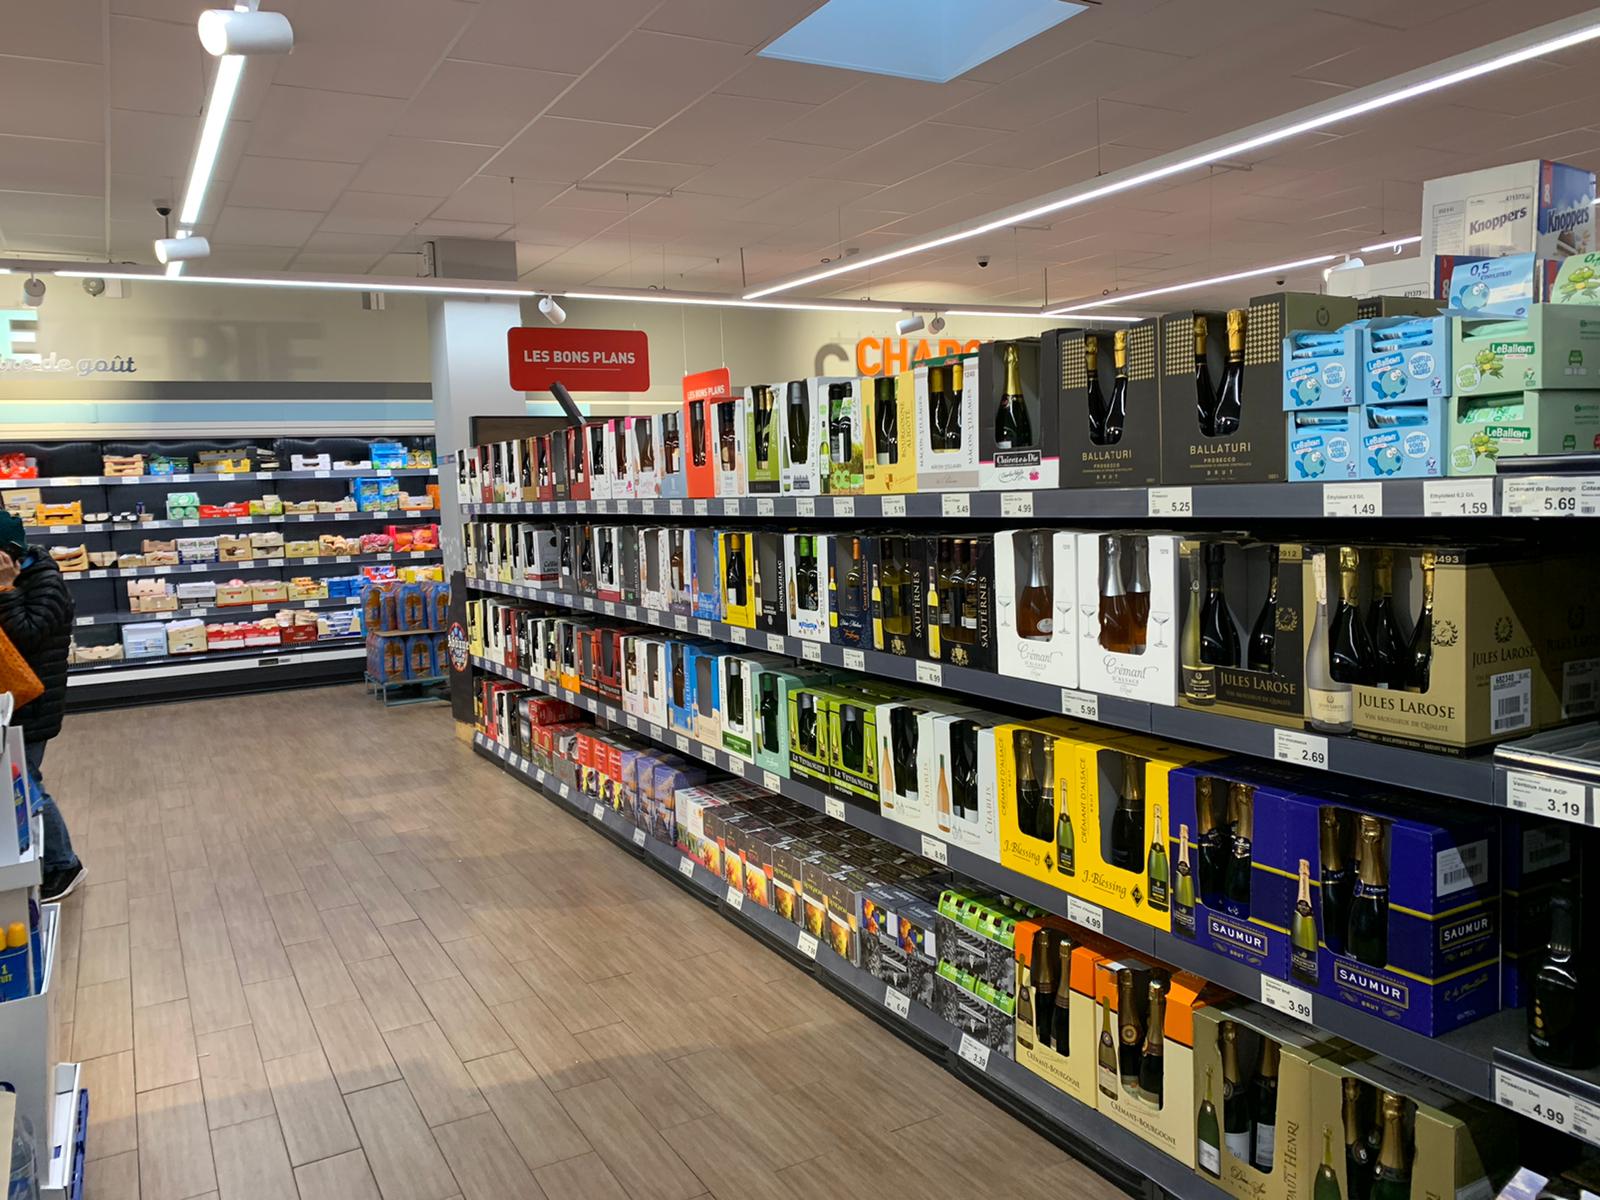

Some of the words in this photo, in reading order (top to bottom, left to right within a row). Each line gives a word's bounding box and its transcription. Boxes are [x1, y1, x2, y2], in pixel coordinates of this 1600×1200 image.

[1469, 205, 1528, 236] Knoppers
[1546, 206, 1590, 237] Knoppers
[1469, 262, 1491, 278] 0,5
[41, 351, 74, 372] de
[77, 355, 137, 377] goût
[524, 350, 550, 363] LES
[553, 350, 590, 363] BONS
[593, 351, 636, 364] PLANS
[687, 391, 696, 400] LES
[696, 388, 708, 399] BONS
[708, 385, 726, 397] PLANS
[1082, 449, 1133, 462] BALLATURI
[1189, 442, 1252, 456] BALLATURI
[1027, 453, 1040, 463] Die
[1203, 456, 1237, 464] PROSECCO
[956, 503, 969, 513] 5.49
[1017, 503, 1032, 513] 4.99
[1171, 501, 1191, 512] 5.25
[1352, 503, 1376, 515] 1.49
[1460, 502, 1488, 515] 1.59
[1544, 496, 1576, 511] 5.69
[777, 560, 785, 612] MONBAZILLAC
[1017, 640, 1064, 664] Crémant
[1472, 650, 1498, 668] JULES
[1501, 646, 1537, 663] LAROSE
[1102, 654, 1160, 679] Crémant
[1112, 676, 1140, 685] D'ALSACE
[1220, 671, 1251, 689] JULES
[1253, 676, 1297, 696] LAROSE
[1080, 704, 1097, 716] 5.99
[1358, 692, 1395, 710] JULES
[1399, 698, 1456, 720] LAROSE
[1301, 749, 1325, 764] 2.69
[984, 785, 993, 835] CHABLIS
[1547, 798, 1580, 816] 3.19
[1080, 803, 1088, 844] CRÉMANT
[1085, 915, 1101, 929] 4.99
[1444, 918, 1488, 942] SAUMUR
[1212, 921, 1263, 948] SAUMUR
[1229, 949, 1245, 959] BRUT
[1339, 968, 1401, 1000] SAUMUR
[1288, 999, 1311, 1017] 3.99
[1360, 1000, 1379, 1012] BRUT
[1499, 1078, 1528, 1094] Prosecco
[1533, 1103, 1565, 1125] 4.99
[1283, 1119, 1300, 1168] HENRI
